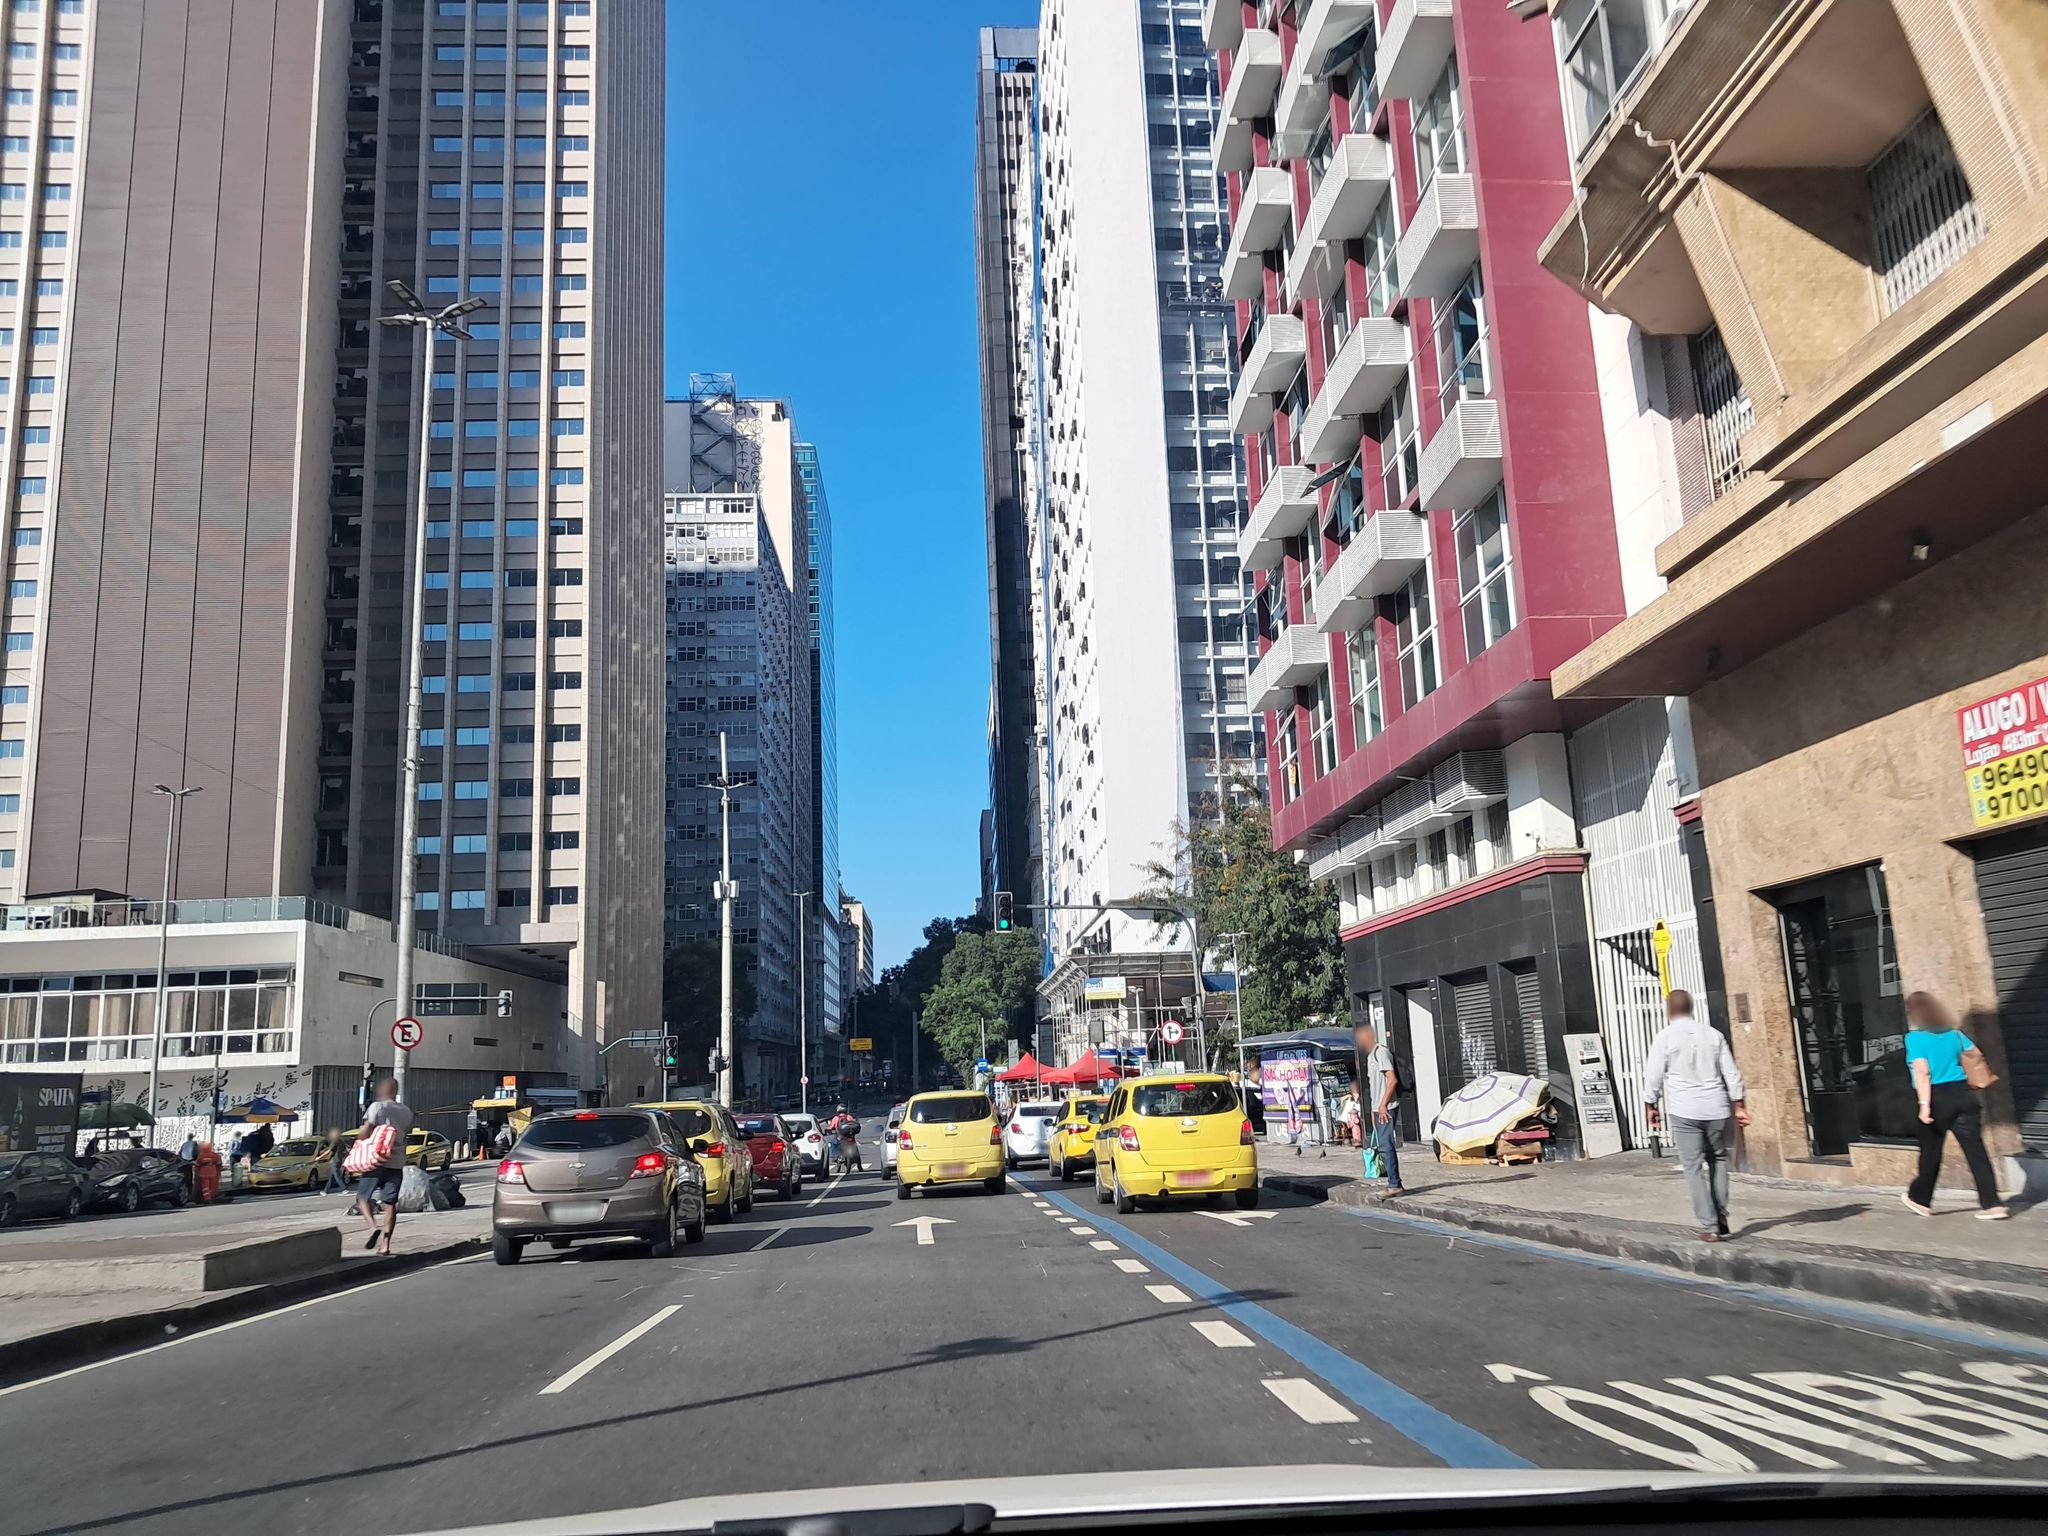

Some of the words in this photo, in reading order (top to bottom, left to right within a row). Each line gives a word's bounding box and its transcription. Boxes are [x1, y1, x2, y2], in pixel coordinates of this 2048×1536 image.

[1963, 692, 2027, 744] ALUGO
[1988, 783, 2048, 818] 9700
[39, 1088, 74, 1107] SPATEN
